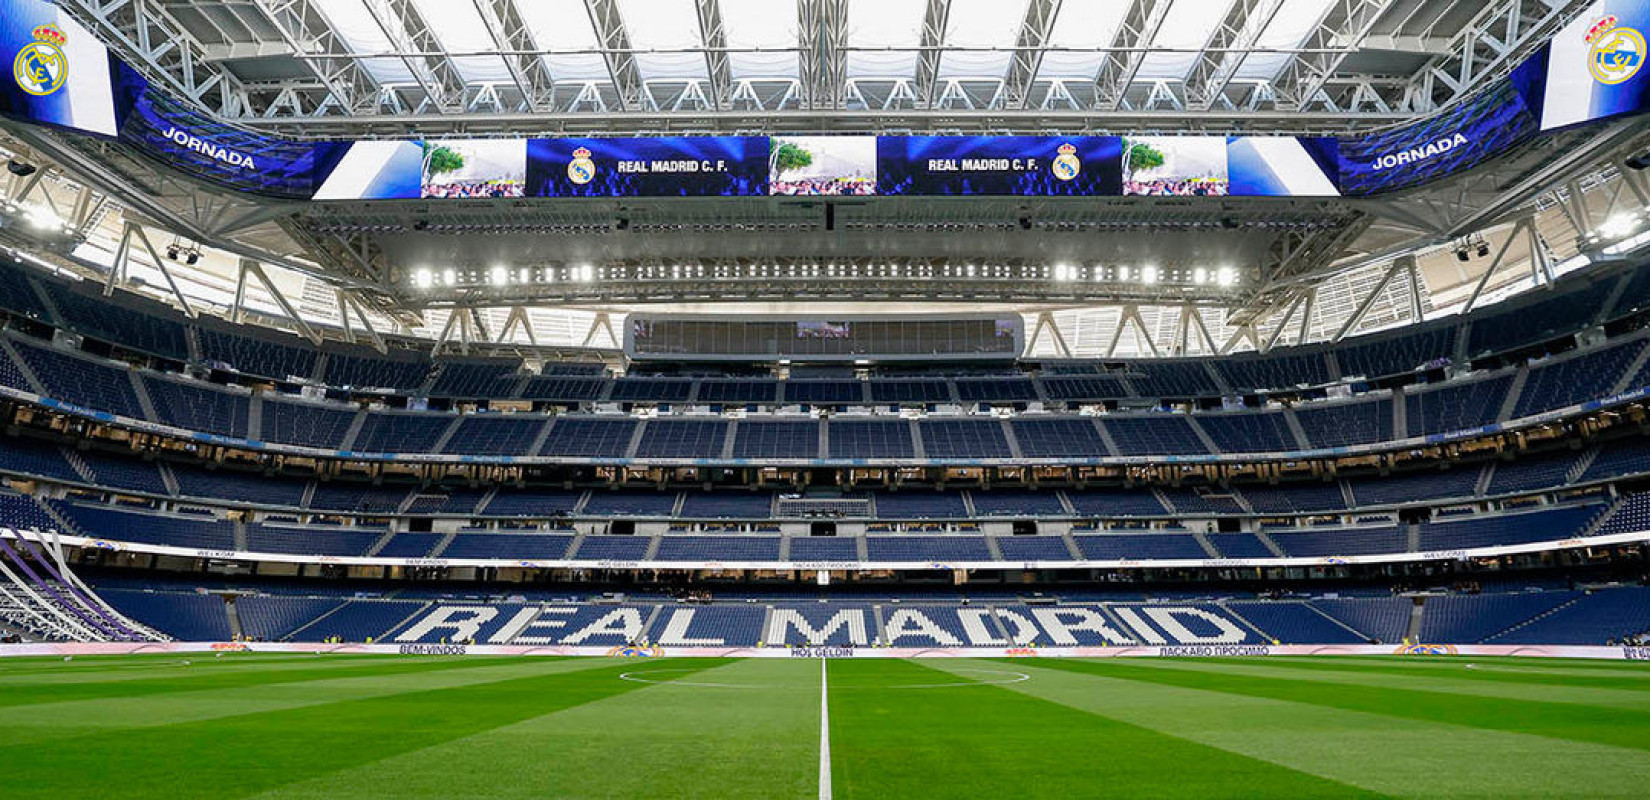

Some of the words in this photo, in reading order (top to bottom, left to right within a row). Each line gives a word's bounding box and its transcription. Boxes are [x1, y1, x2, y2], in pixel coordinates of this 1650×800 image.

[162, 126, 255, 169] JORNADA
[1372, 132, 1468, 170] JORNADA
[618, 160, 649, 172] REAL
[651, 160, 699, 172] MADRID
[701, 160, 714, 172] C.
[717, 160, 728, 172] F.
[928, 159, 959, 171] REAL
[962, 159, 1009, 171] MADRID
[1012, 159, 1025, 171] C.
[1028, 159, 1039, 171] F.
[394, 605, 725, 646] REAL
[766, 606, 1247, 647] MADRID
[399, 644, 466, 655] BEM-VINDOS
